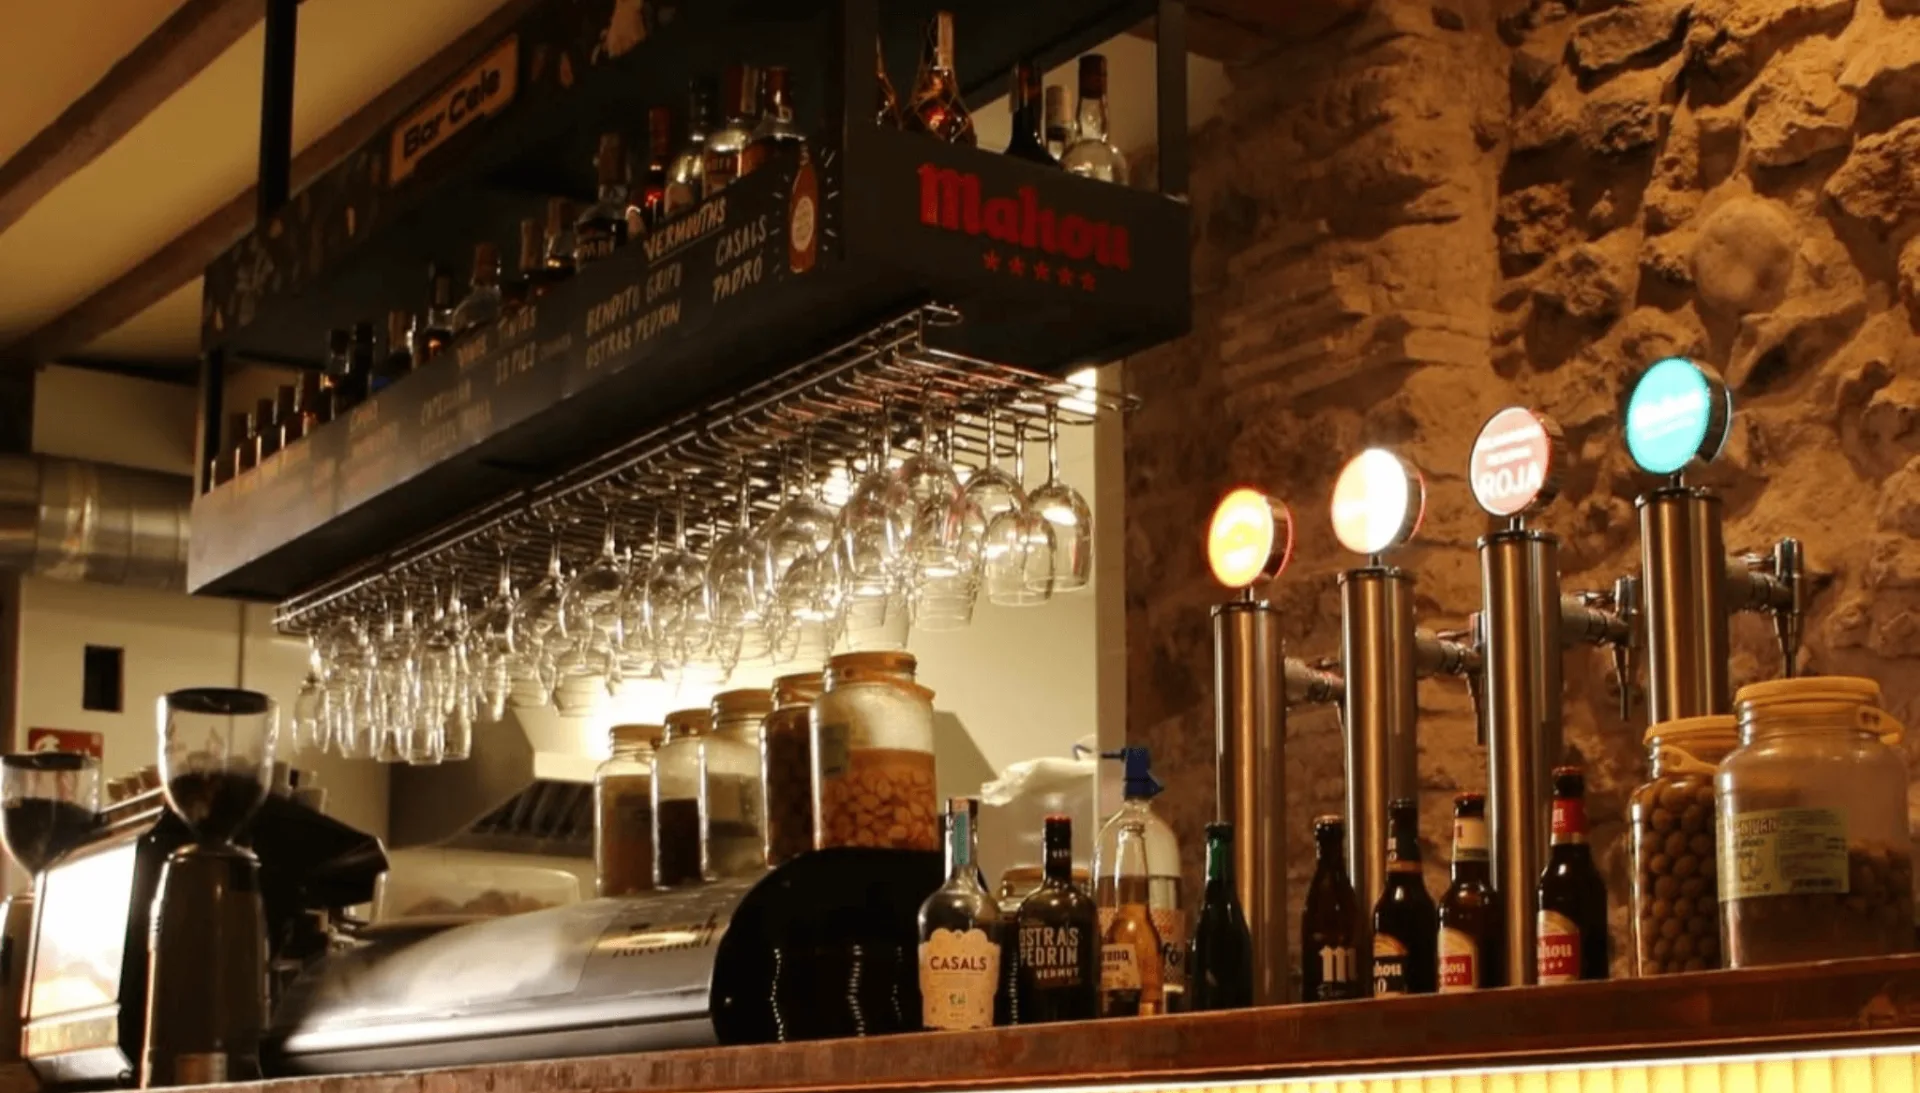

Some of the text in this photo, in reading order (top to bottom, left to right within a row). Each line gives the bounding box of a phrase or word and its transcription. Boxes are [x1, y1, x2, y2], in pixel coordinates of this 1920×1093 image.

[403, 111, 446, 160] Bar
[916, 161, 1131, 271] Mahou
[715, 214, 767, 267] CASALS
[585, 323, 632, 371] OSTRAS
[1479, 460, 1541, 502] ROJA
[930, 956, 987, 970] CASALS
[1019, 947, 1079, 968] PEDRIN
